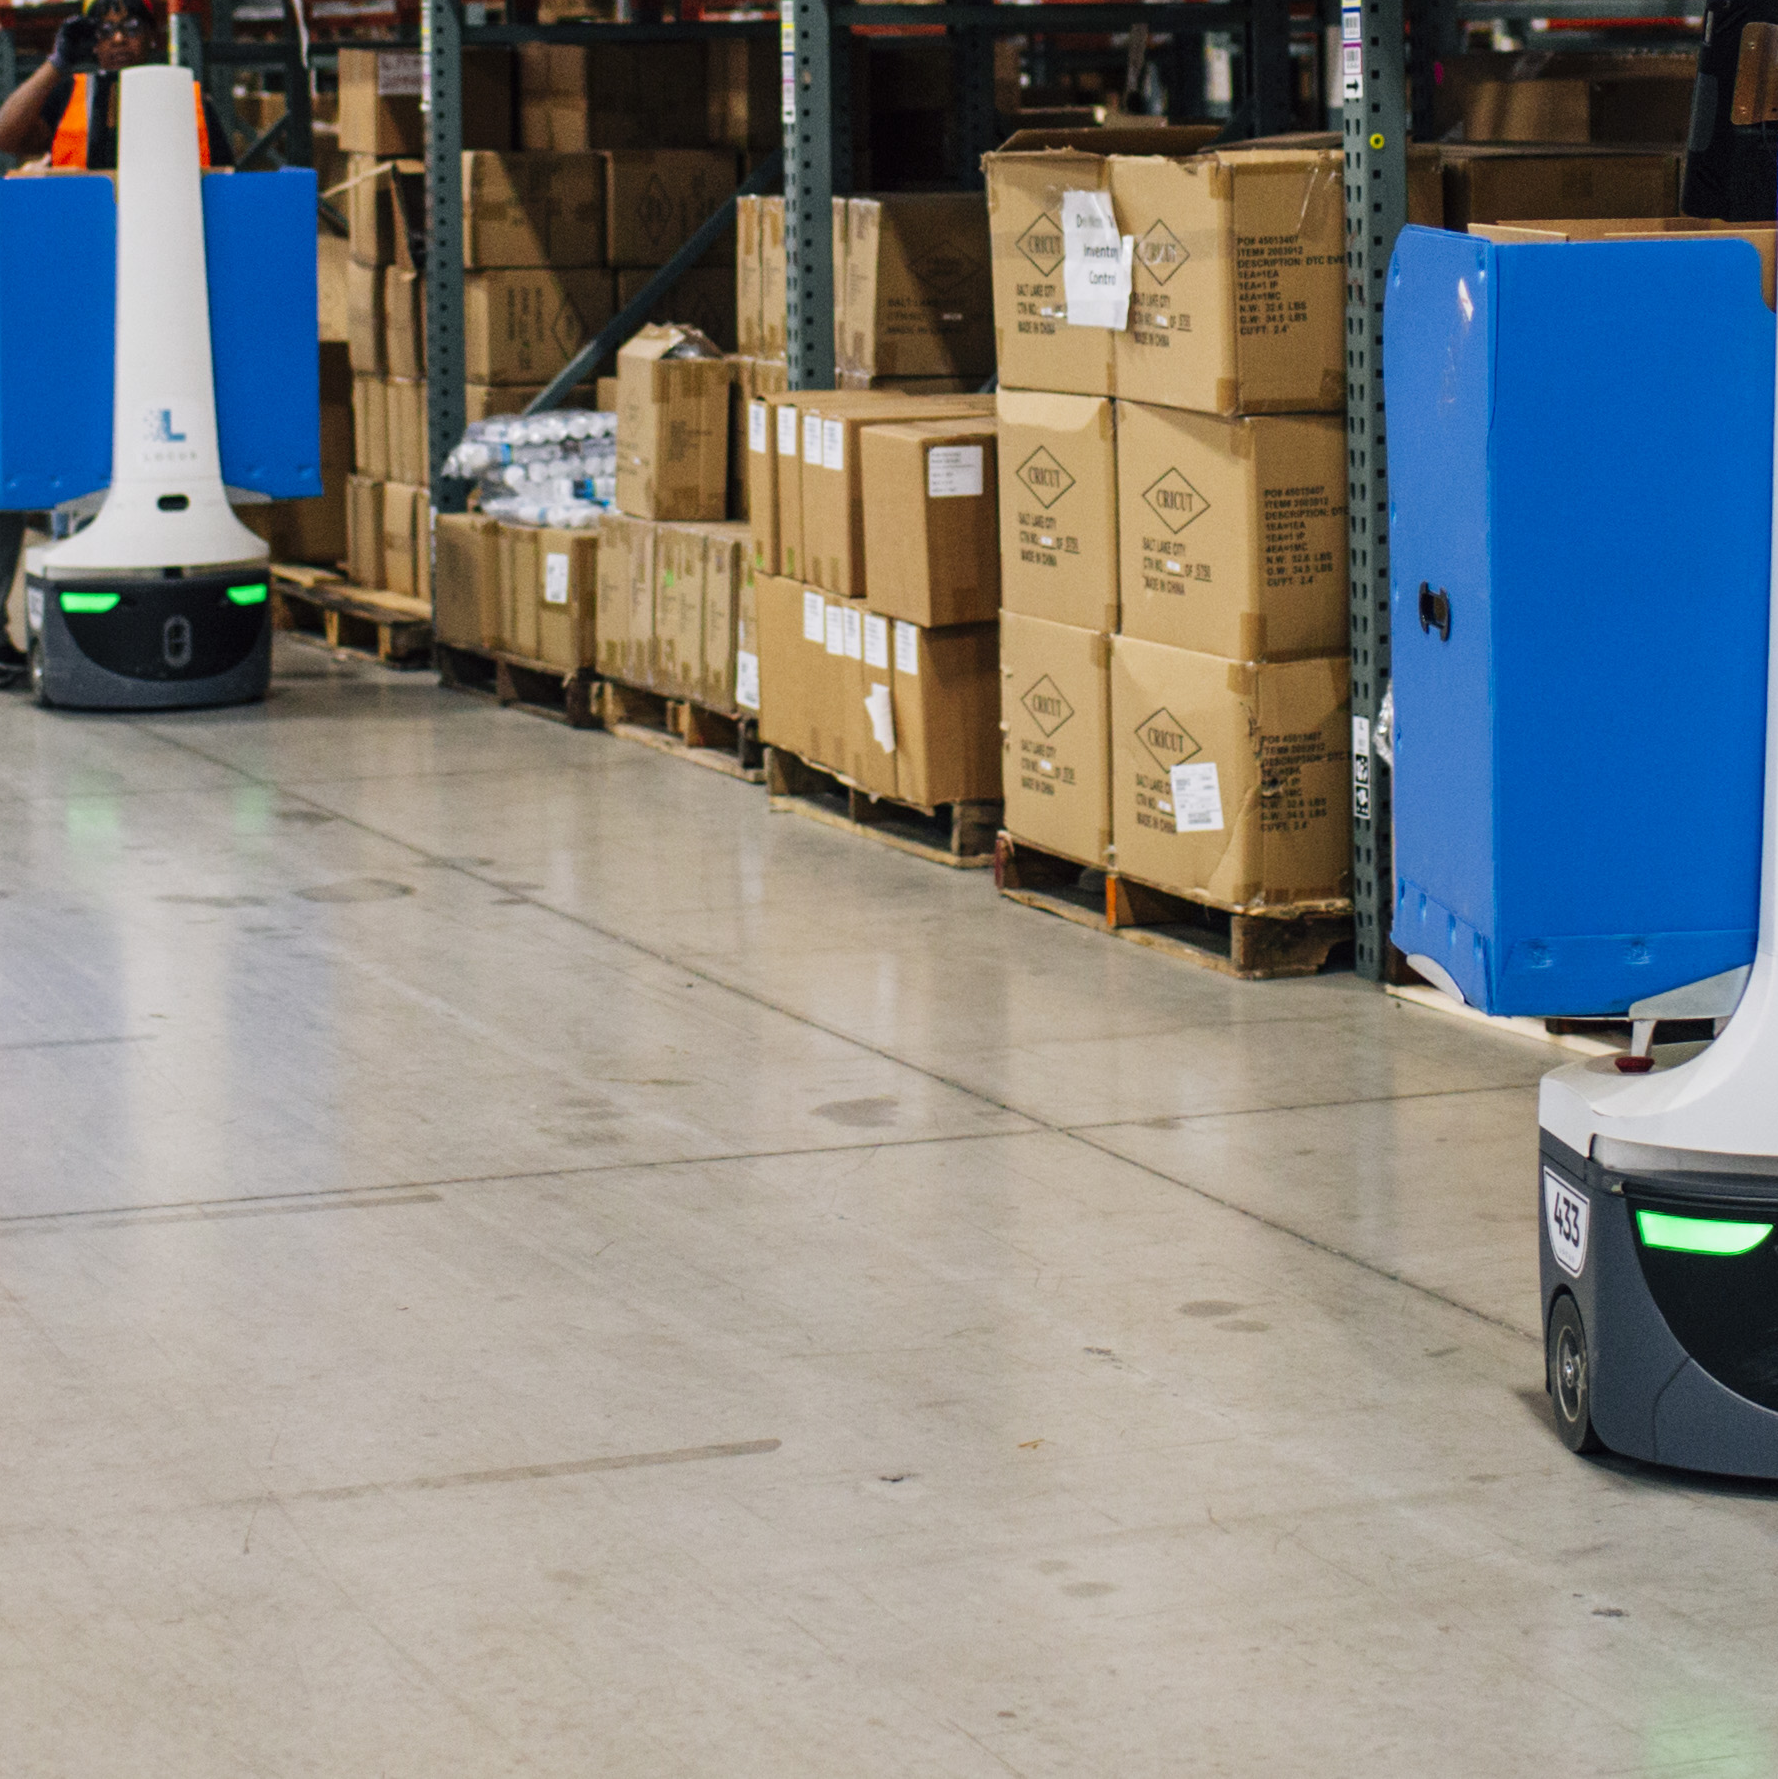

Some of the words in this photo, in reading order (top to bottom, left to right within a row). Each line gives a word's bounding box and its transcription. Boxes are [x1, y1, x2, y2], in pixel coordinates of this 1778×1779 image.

[1028, 235, 1060, 255] CRICUT
[1237, 237, 1256, 245] PO#
[1238, 249, 1264, 257] ITEM#
[1306, 256, 1324, 265] DTC
[1288, 302, 1307, 311] LBS
[1028, 466, 1061, 488] CRICUT
[1156, 489, 1193, 512] CRICUT
[1148, 727, 1184, 753] CRICUT
[1552, 1191, 1581, 1248] 433
